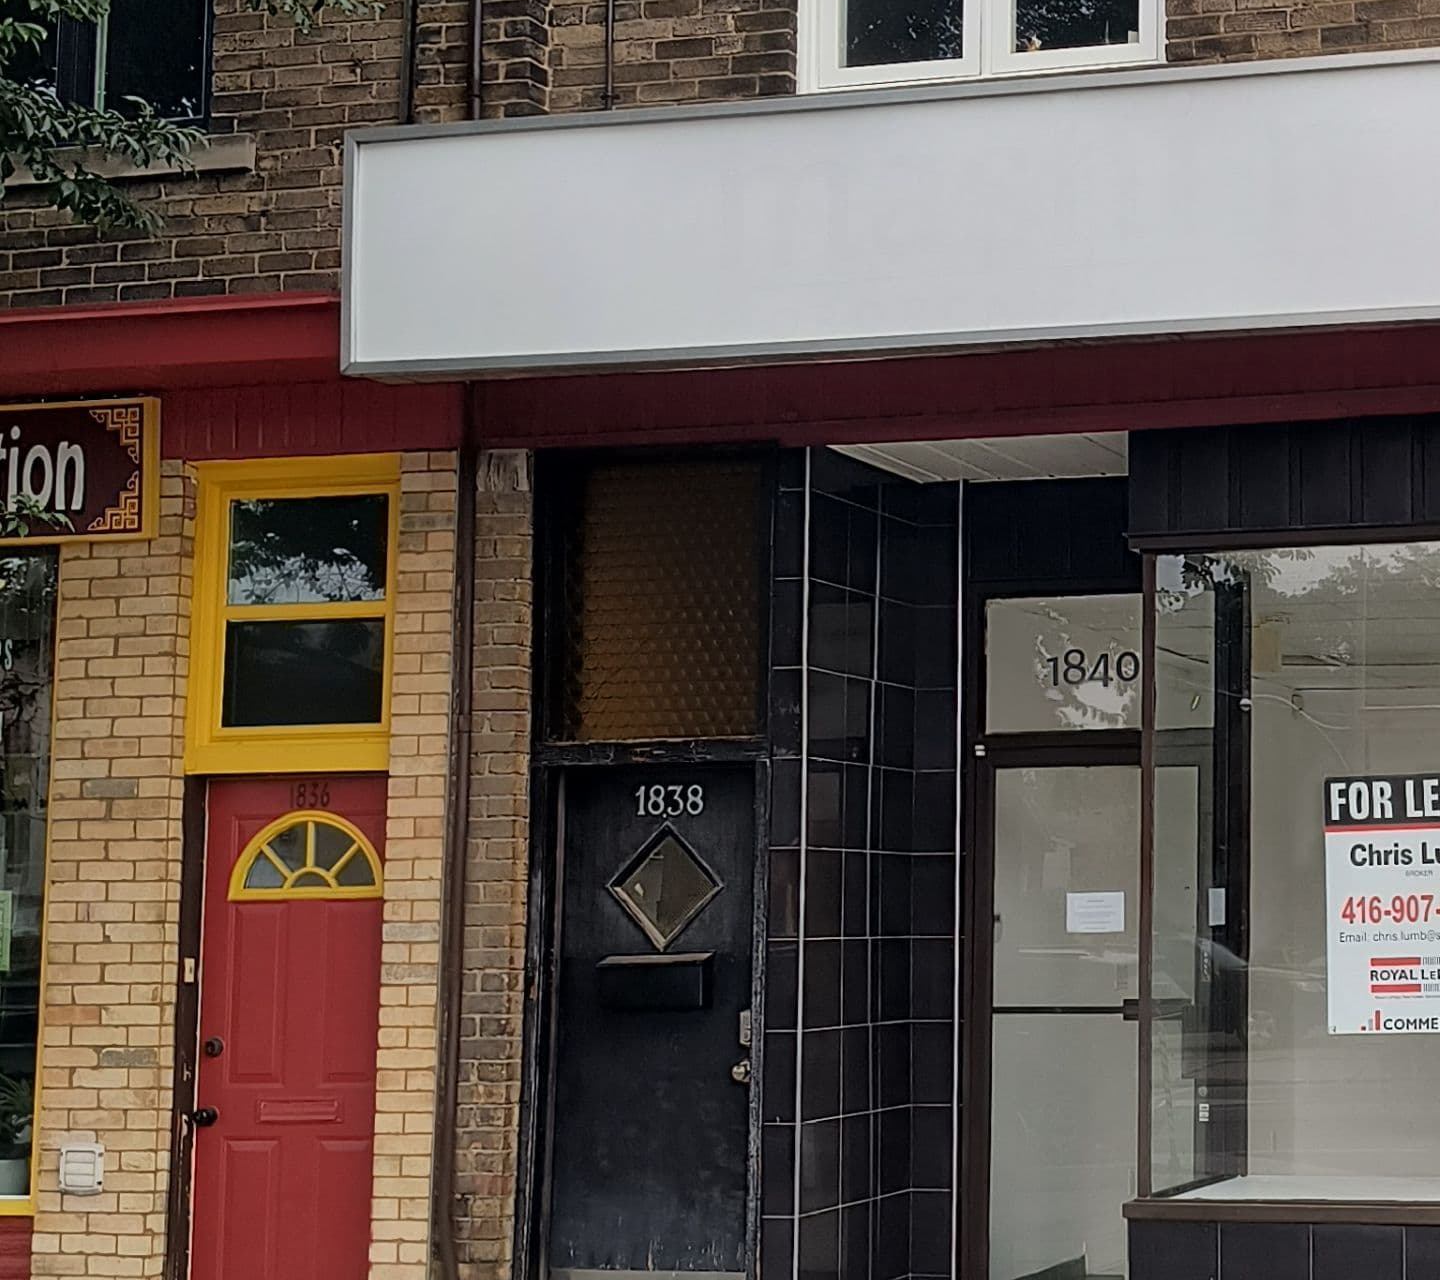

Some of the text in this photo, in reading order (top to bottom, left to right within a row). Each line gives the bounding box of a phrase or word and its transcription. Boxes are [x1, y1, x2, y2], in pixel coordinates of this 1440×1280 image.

[0, 425, 85, 512] ion
[1046, 648, 1140, 687] 1840
[289, 782, 331, 810] 1836
[635, 784, 704, 816] 1838
[1330, 781, 1393, 821] FOR
[1350, 842, 1413, 867] Chris
[1370, 969, 1418, 981] ROYAL
